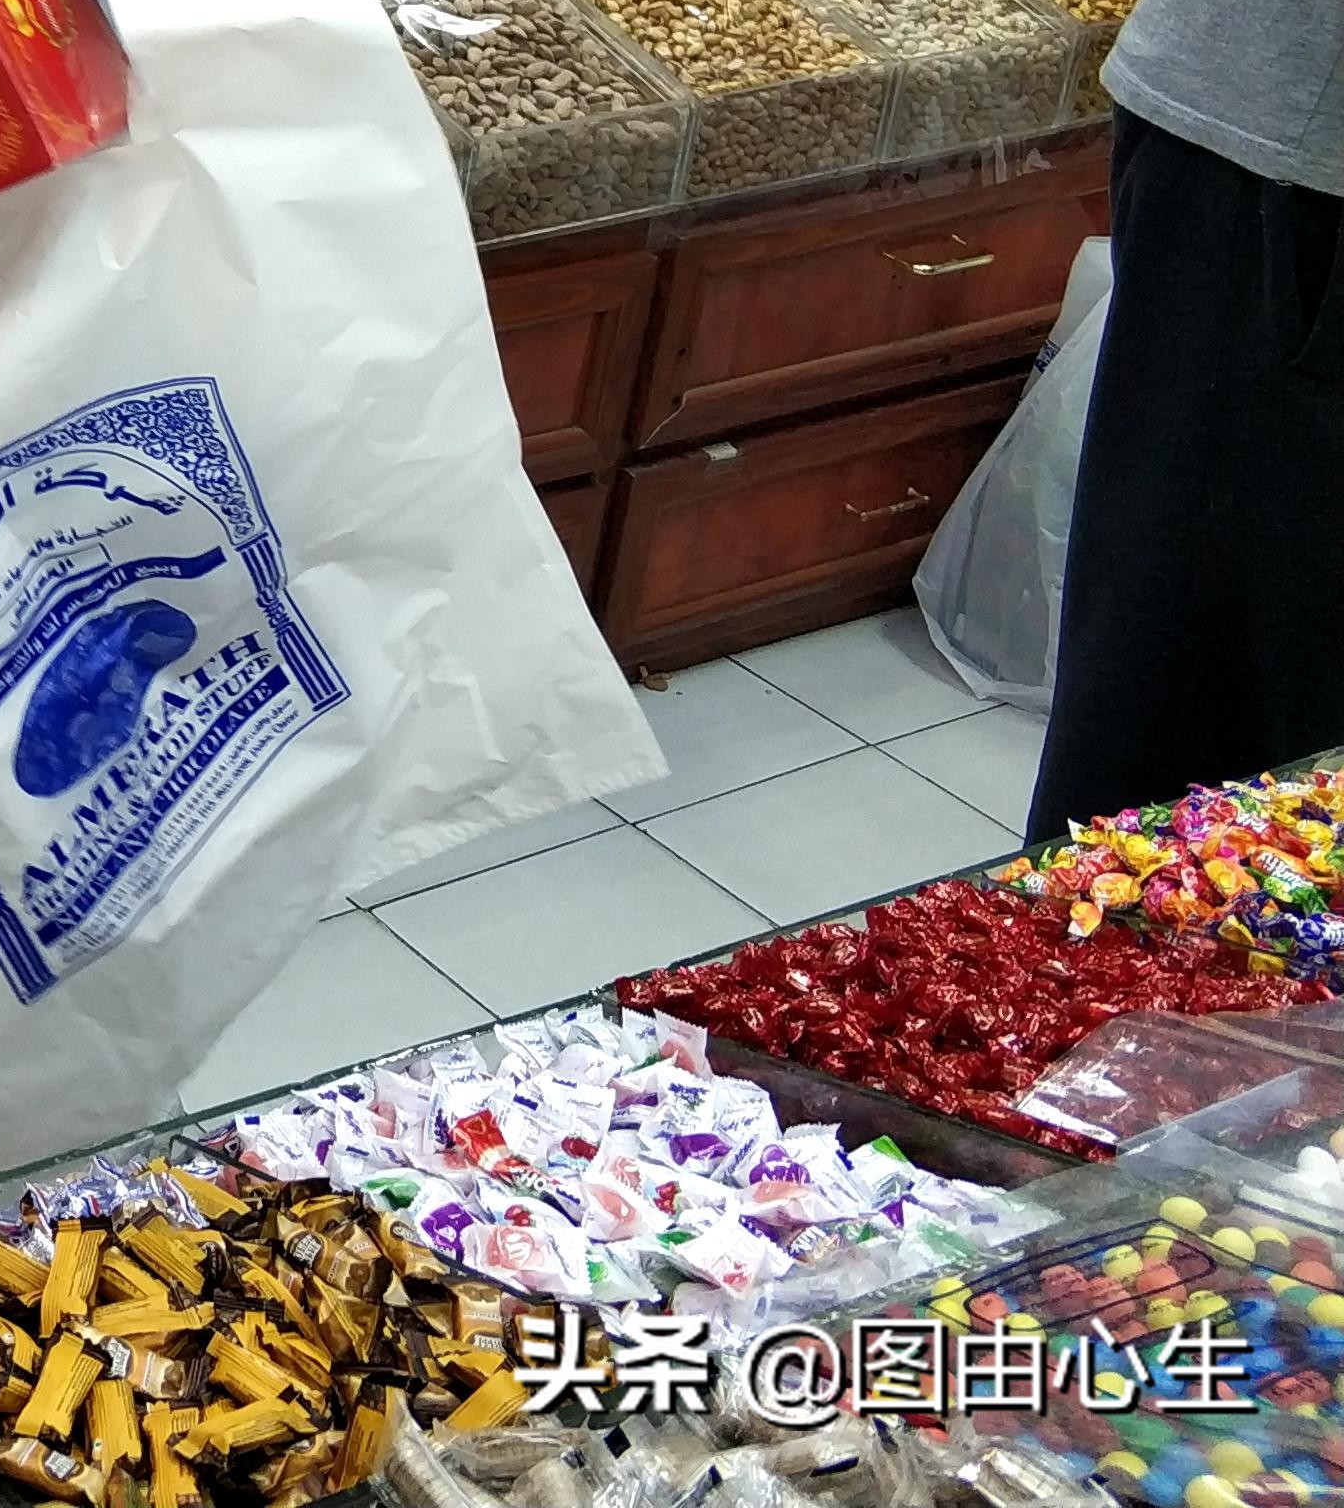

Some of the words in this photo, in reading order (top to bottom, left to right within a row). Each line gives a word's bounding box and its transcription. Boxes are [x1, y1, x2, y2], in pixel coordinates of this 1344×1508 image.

[34, 462, 187, 516] شركة
[193, 652, 274, 726] STUFF
[151, 680, 275, 812] CHOCOLATE
